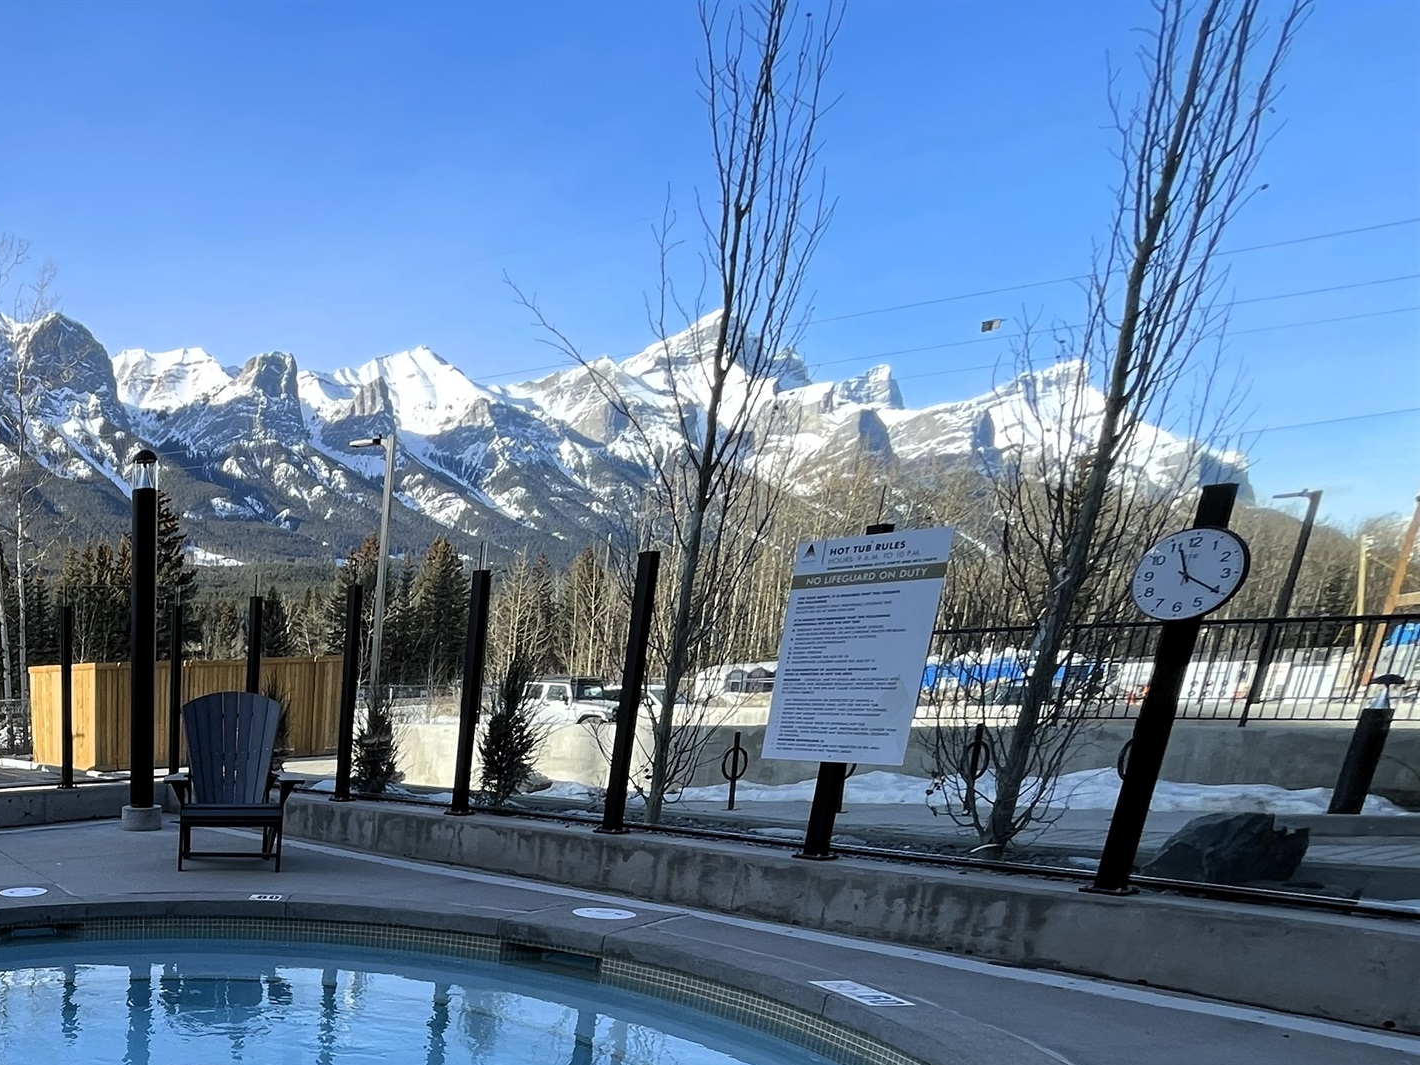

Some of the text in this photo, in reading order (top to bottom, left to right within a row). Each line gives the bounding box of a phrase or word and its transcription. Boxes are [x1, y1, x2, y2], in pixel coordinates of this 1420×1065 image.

[829, 540, 906, 556] HOT TUB RULES
[1171, 543, 1183, 553] 11
[1189, 537, 1203, 548] 12
[1213, 541, 1218, 551] 1
[1151, 555, 1166, 566] 10
[1220, 552, 1231, 562] 2
[806, 567, 929, 586] NO LIFEGUARD ON DUTY
[1144, 571, 1154, 582] 9
[1221, 568, 1231, 579] 3
[1144, 587, 1154, 598] 8
[1155, 598, 1165, 609] 7
[1172, 602, 1183, 613] 6
[1192, 597, 1203, 608] 5
